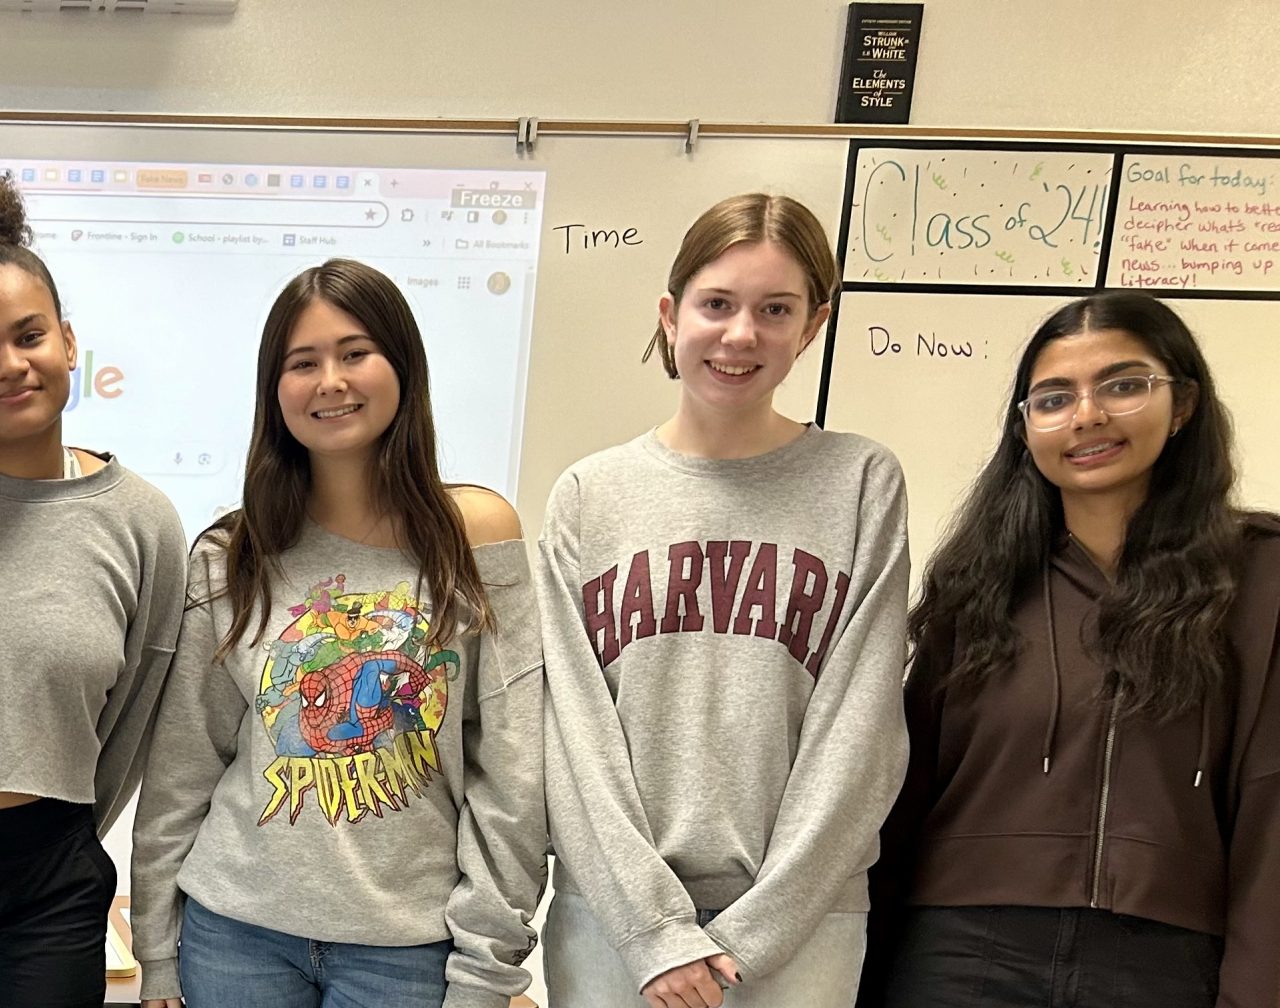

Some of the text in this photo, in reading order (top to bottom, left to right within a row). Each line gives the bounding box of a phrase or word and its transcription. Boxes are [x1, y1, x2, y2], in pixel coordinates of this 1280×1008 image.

[863, 36, 904, 46] STRUNK
[872, 48, 906, 59] WHITE
[873, 69, 887, 79] The
[852, 78, 906, 89] ELEMENTS
[873, 89, 882, 98] of
[861, 96, 893, 107] STYLE
[1126, 162, 1275, 195] Goal for today:
[460, 190, 523, 207] Freeze
[863, 160, 991, 262] Class
[1005, 202, 1031, 230] of
[1129, 196, 1190, 222] Learning
[1195, 200, 1221, 214] how
[1225, 202, 1240, 214] to
[1124, 216, 1193, 233] decipher
[1198, 219, 1246, 234] what's
[130, 232, 148, 242] Sign
[188, 234, 216, 242] School
[222, 234, 250, 244] playlist
[299, 236, 337, 246] Staff Hub
[552, 224, 643, 254] Time
[473, 240, 529, 250] All Bookmarks
[1180, 239, 1219, 252] when
[1224, 239, 1240, 252] it
[1244, 241, 1280, 253] come
[1182, 258, 1243, 275] bumping
[1253, 260, 1273, 275] up
[407, 276, 439, 288] Images
[868, 326, 902, 356] Do
[257, 728, 444, 828] SPIDER-MAN
